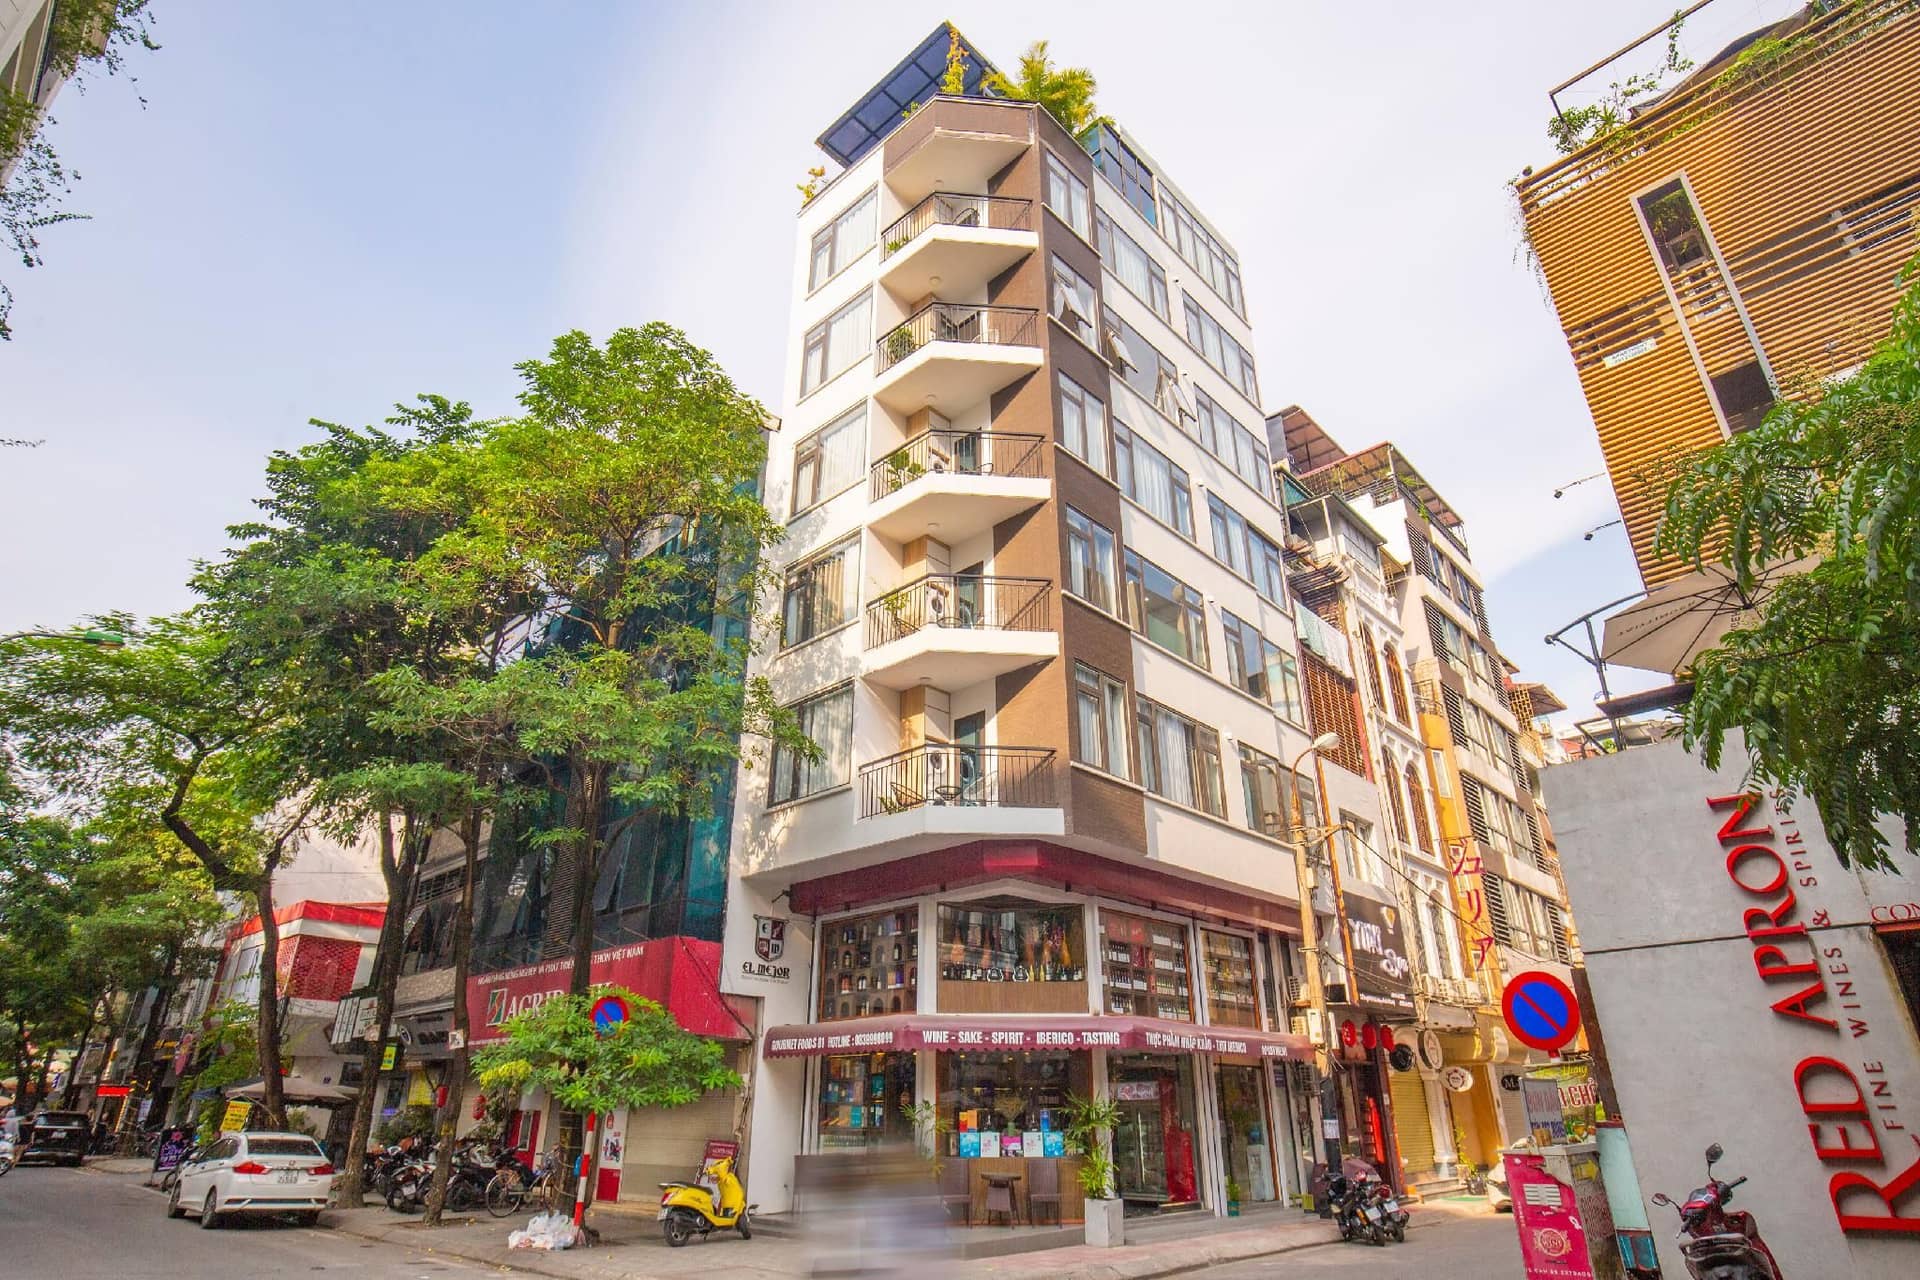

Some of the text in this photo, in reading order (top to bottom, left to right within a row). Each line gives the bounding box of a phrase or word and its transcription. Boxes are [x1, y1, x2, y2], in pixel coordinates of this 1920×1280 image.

[627, 946, 644, 958] NAM
[758, 963, 790, 977] MEJOR
[1823, 945, 1870, 1040] WINES
[1706, 791, 1920, 1234] RED APRON
[797, 1037, 817, 1050] FOODS
[827, 1035, 851, 1048] HOTLINE
[922, 1030, 949, 1044] WINE
[958, 1030, 983, 1044] SAKE
[991, 1031, 1024, 1045] SPIRIT
[1036, 1031, 1074, 1045] IBERICO
[1082, 1031, 1120, 1045] TASTING
[1862, 1060, 1905, 1131] FINE
